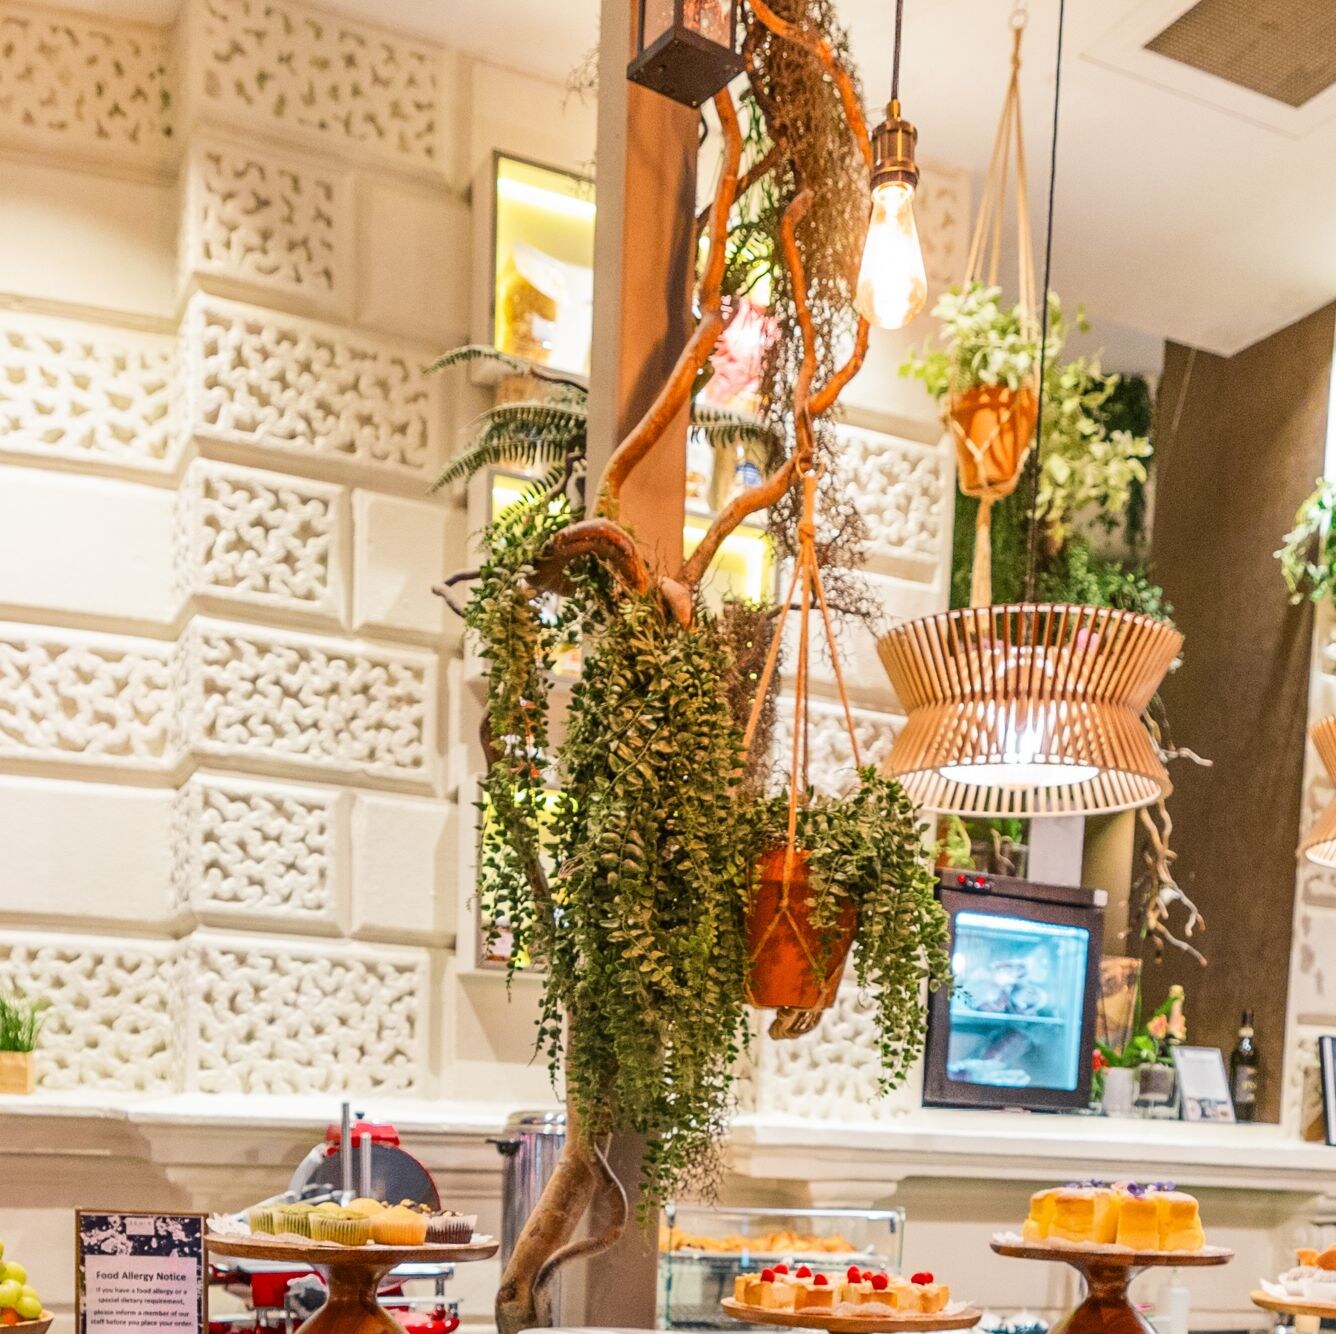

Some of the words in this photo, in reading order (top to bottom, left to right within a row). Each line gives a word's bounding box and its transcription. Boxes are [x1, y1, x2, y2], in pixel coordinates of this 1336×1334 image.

[96, 1271, 119, 1280] Food
[121, 1272, 154, 1282] Allergy
[156, 1272, 187, 1281] Notice
